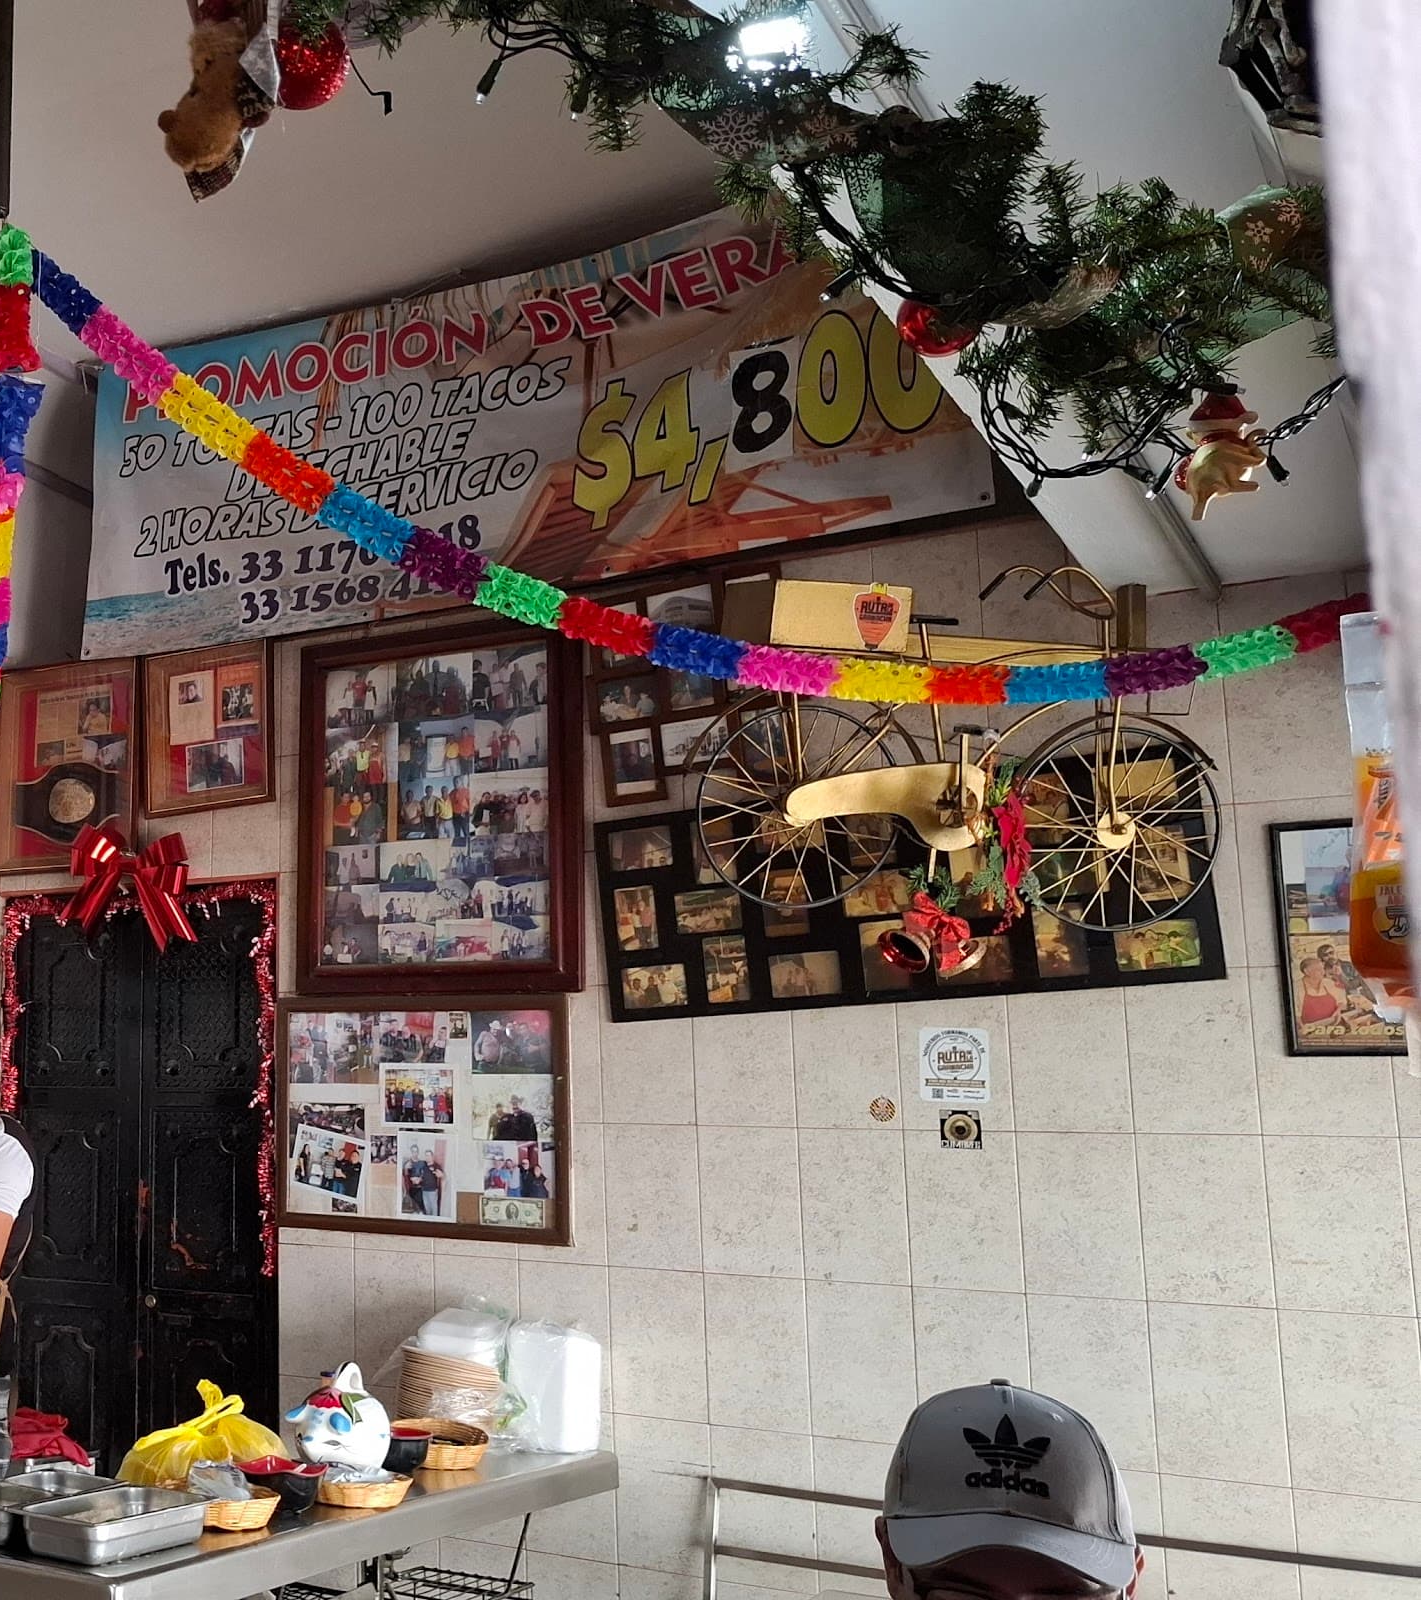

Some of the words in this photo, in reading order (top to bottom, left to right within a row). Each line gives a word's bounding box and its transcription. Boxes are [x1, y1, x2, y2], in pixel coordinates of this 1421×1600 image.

[123, 306, 487, 423] POMOCIÓN
[520, 285, 616, 348] DE
[615, 234, 797, 319] VERA
[119, 433, 166, 477] 50
[172, 405, 321, 467] TOTAS
[350, 382, 422, 439] 100
[431, 356, 572, 417] TACOS
[133, 515, 159, 558] 2
[160, 499, 290, 553] HORAS
[355, 449, 538, 518] SERVICIO
[164, 552, 229, 595] Tels.
[238, 550, 283, 584] 33
[242, 589, 280, 623] 33
[290, 575, 380, 612] 1568
[938, 1050, 966, 1064] RUTA
[965, 1468, 1050, 1499] adidas
